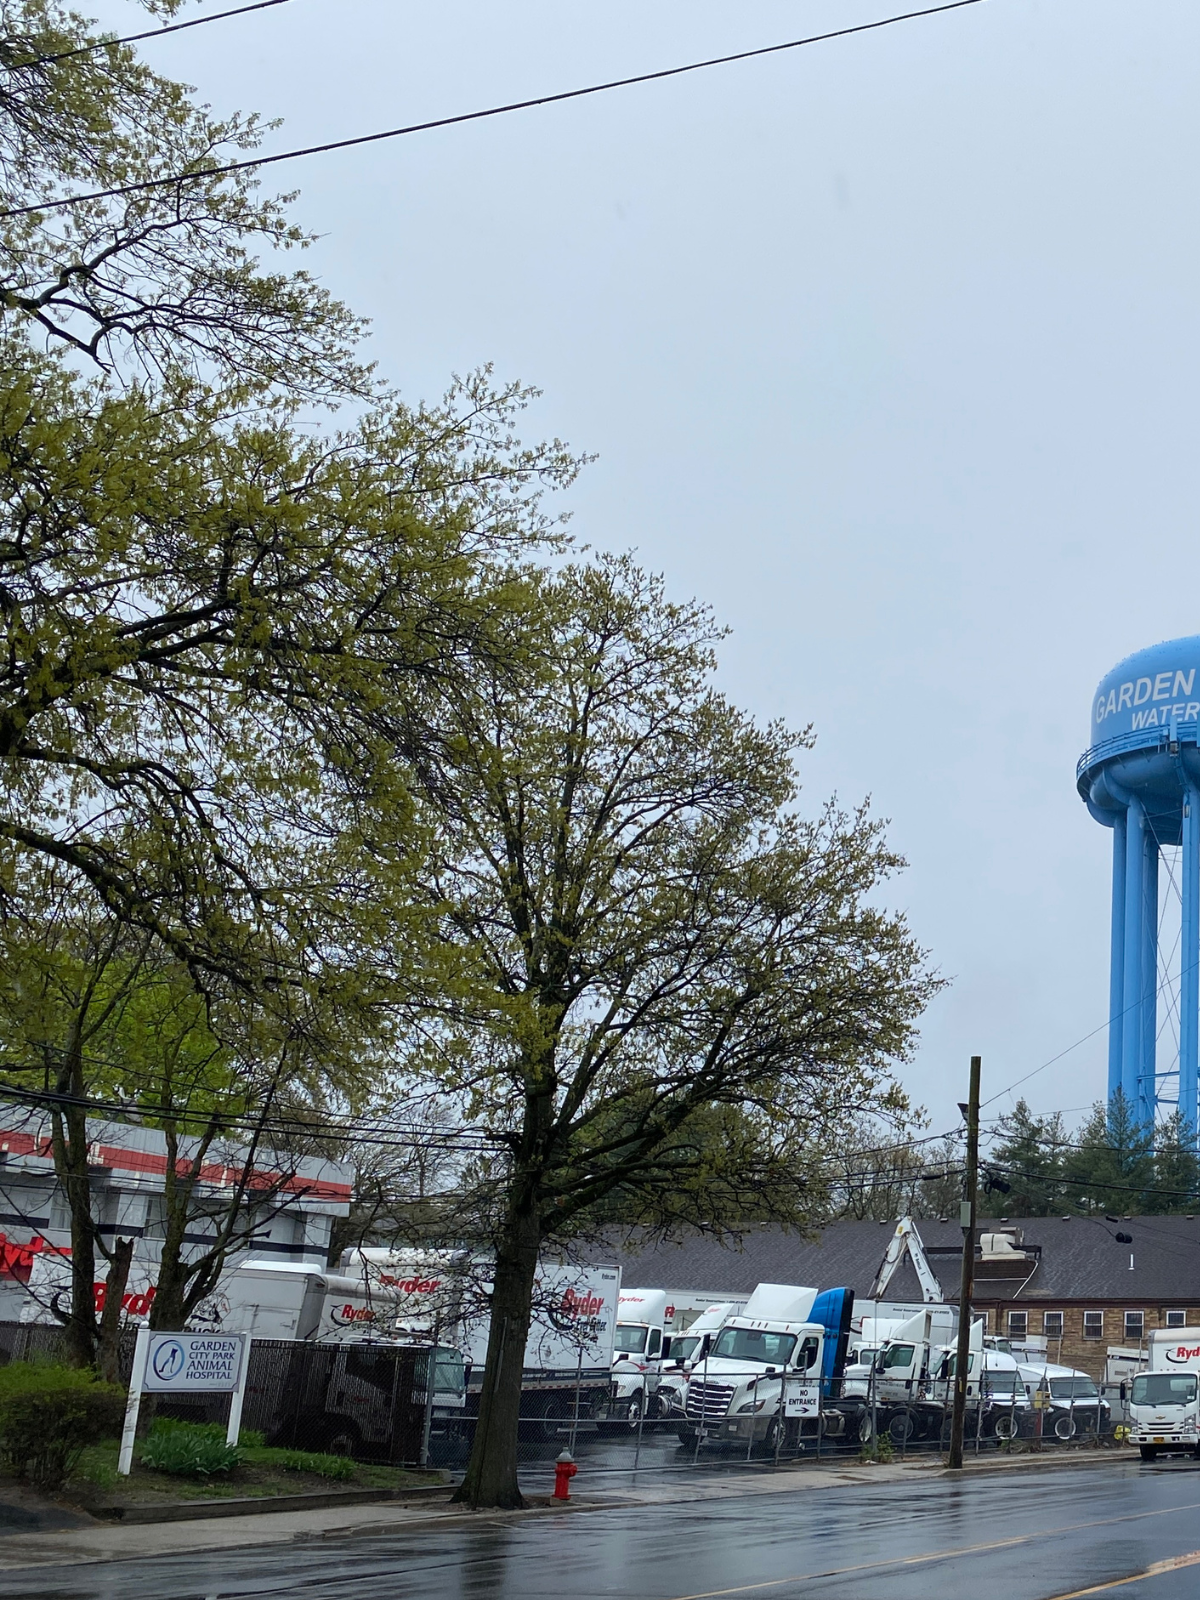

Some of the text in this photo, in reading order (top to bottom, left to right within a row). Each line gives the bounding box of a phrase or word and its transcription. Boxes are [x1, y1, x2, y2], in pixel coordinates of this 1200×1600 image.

[1096, 668, 1196, 724] GARDEN
[1131, 701, 1200, 731] WATER
[190, 1341, 237, 1351] GARDEN
[189, 1352, 235, 1360] CITY PARK
[187, 1360, 233, 1371] ANIMAL
[186, 1371, 232, 1380] HOSPITAL
